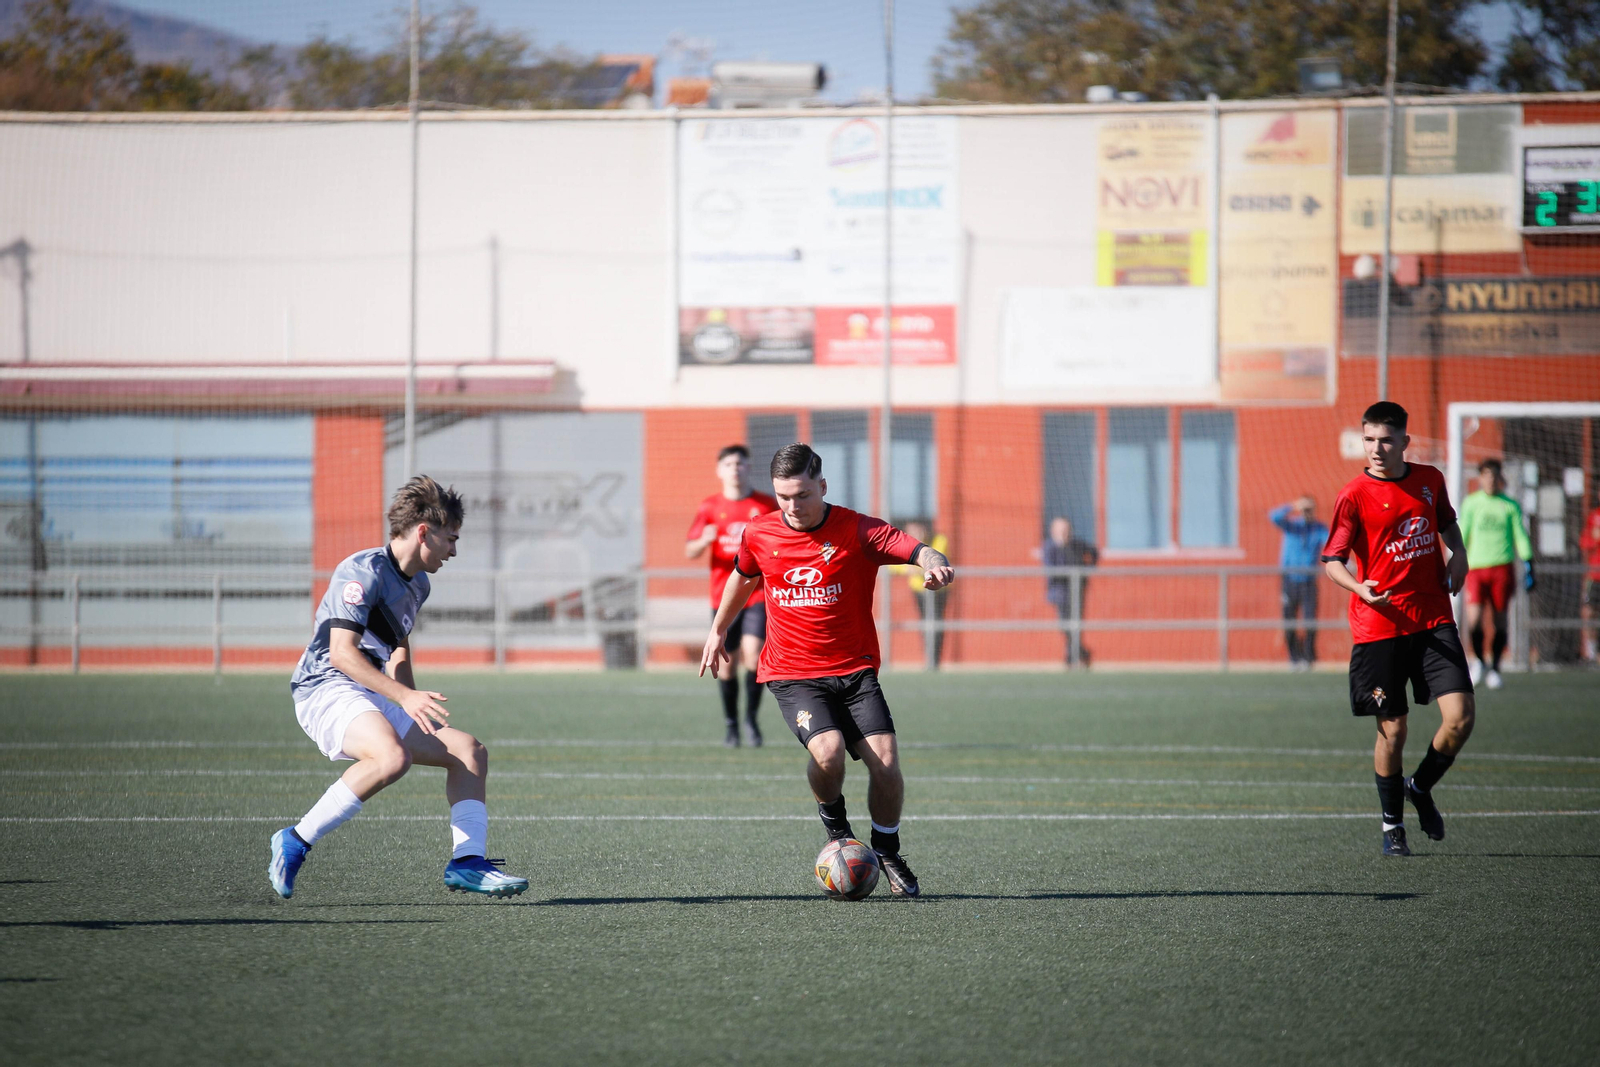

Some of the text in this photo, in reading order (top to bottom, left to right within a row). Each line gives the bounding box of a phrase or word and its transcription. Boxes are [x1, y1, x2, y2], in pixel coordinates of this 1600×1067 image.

[1100, 175, 1200, 211] NOVI
[1535, 190, 1559, 227] 2
[1576, 178, 1600, 215] 3
[1396, 199, 1507, 230] cajamar
[1446, 280, 1600, 312] HYUNDAI
[772, 583, 843, 600] HYUNDAI
[779, 596, 839, 608] ALMERIALVA
